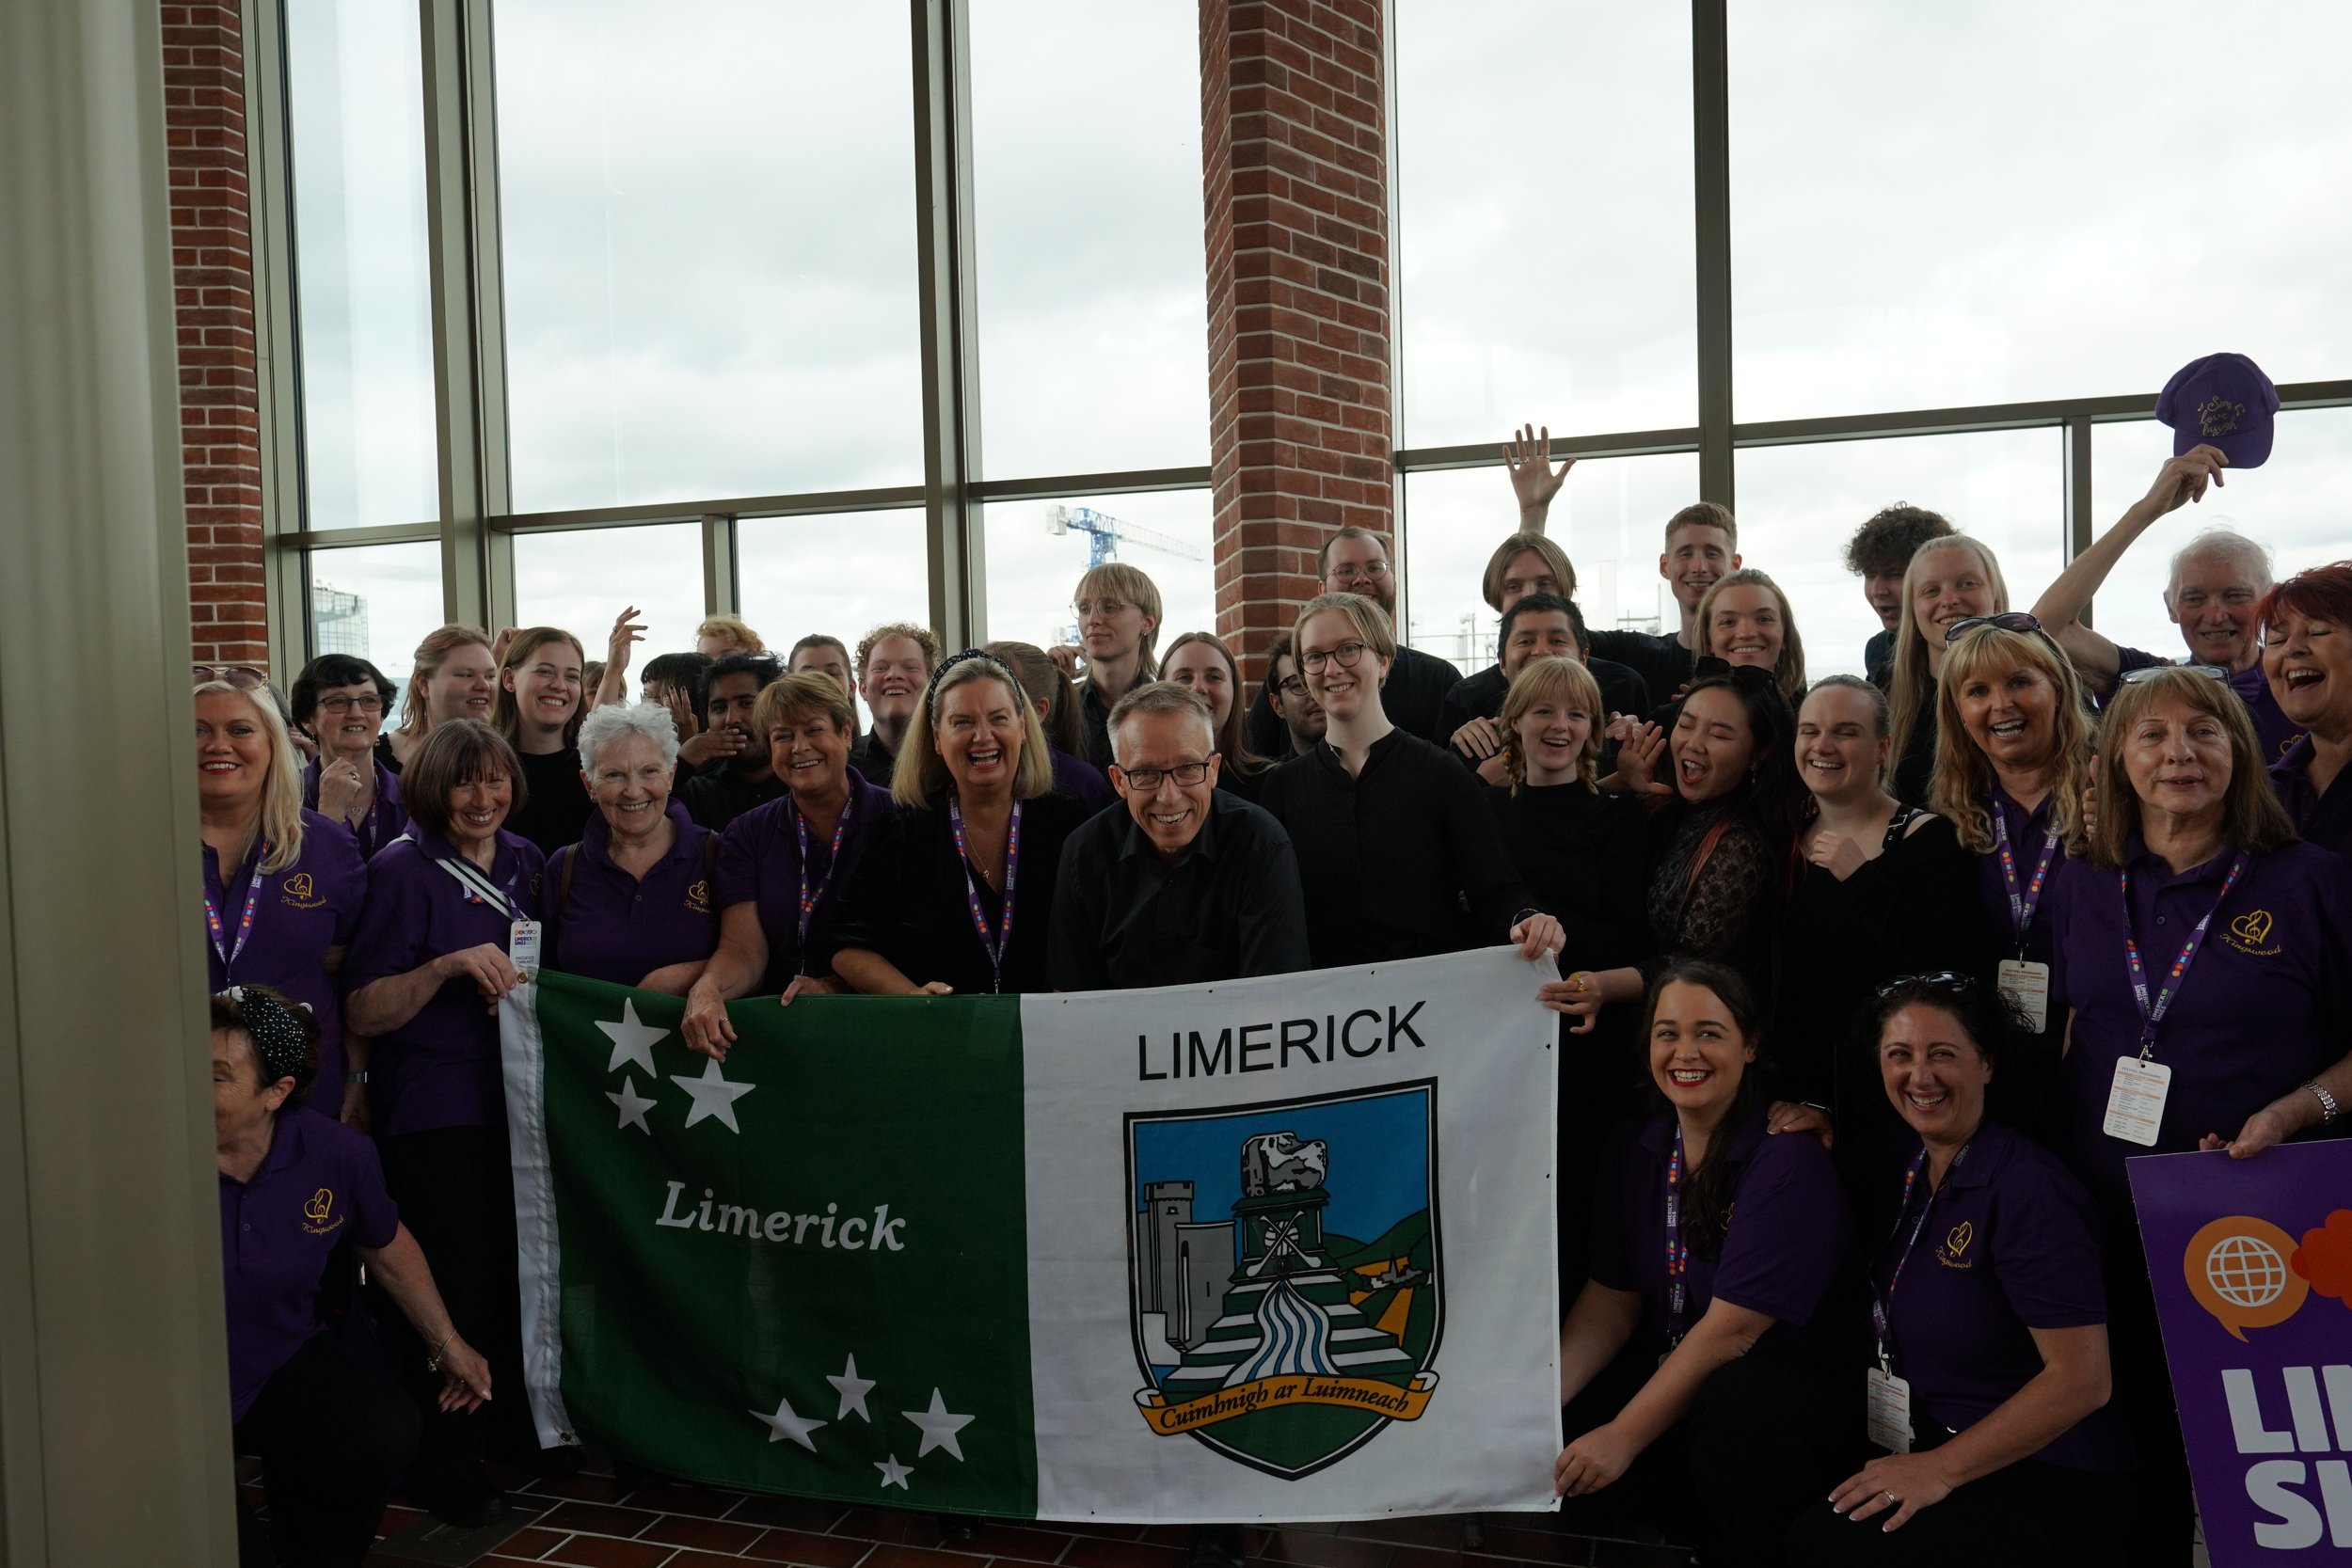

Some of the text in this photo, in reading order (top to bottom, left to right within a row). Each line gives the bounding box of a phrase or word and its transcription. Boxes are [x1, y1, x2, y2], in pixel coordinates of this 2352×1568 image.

[280, 895, 326, 909] Kingswood
[2219, 933, 2282, 956] Kingswood
[2134, 984, 2142, 1001] SINGS
[2138, 983, 2150, 1009] LIMERICK
[2150, 993, 2165, 1021] LIMERICK
[2154, 1005, 2166, 1022] SINGS
[1139, 1000, 1426, 1081] LIMERICK
[301, 1213, 343, 1236] Kingswood
[656, 1180, 906, 1251] Limerick
[1935, 1245, 1973, 1269] Kingswood
[1160, 1377, 1409, 1430] Cuimhnigh ar Luimneach
